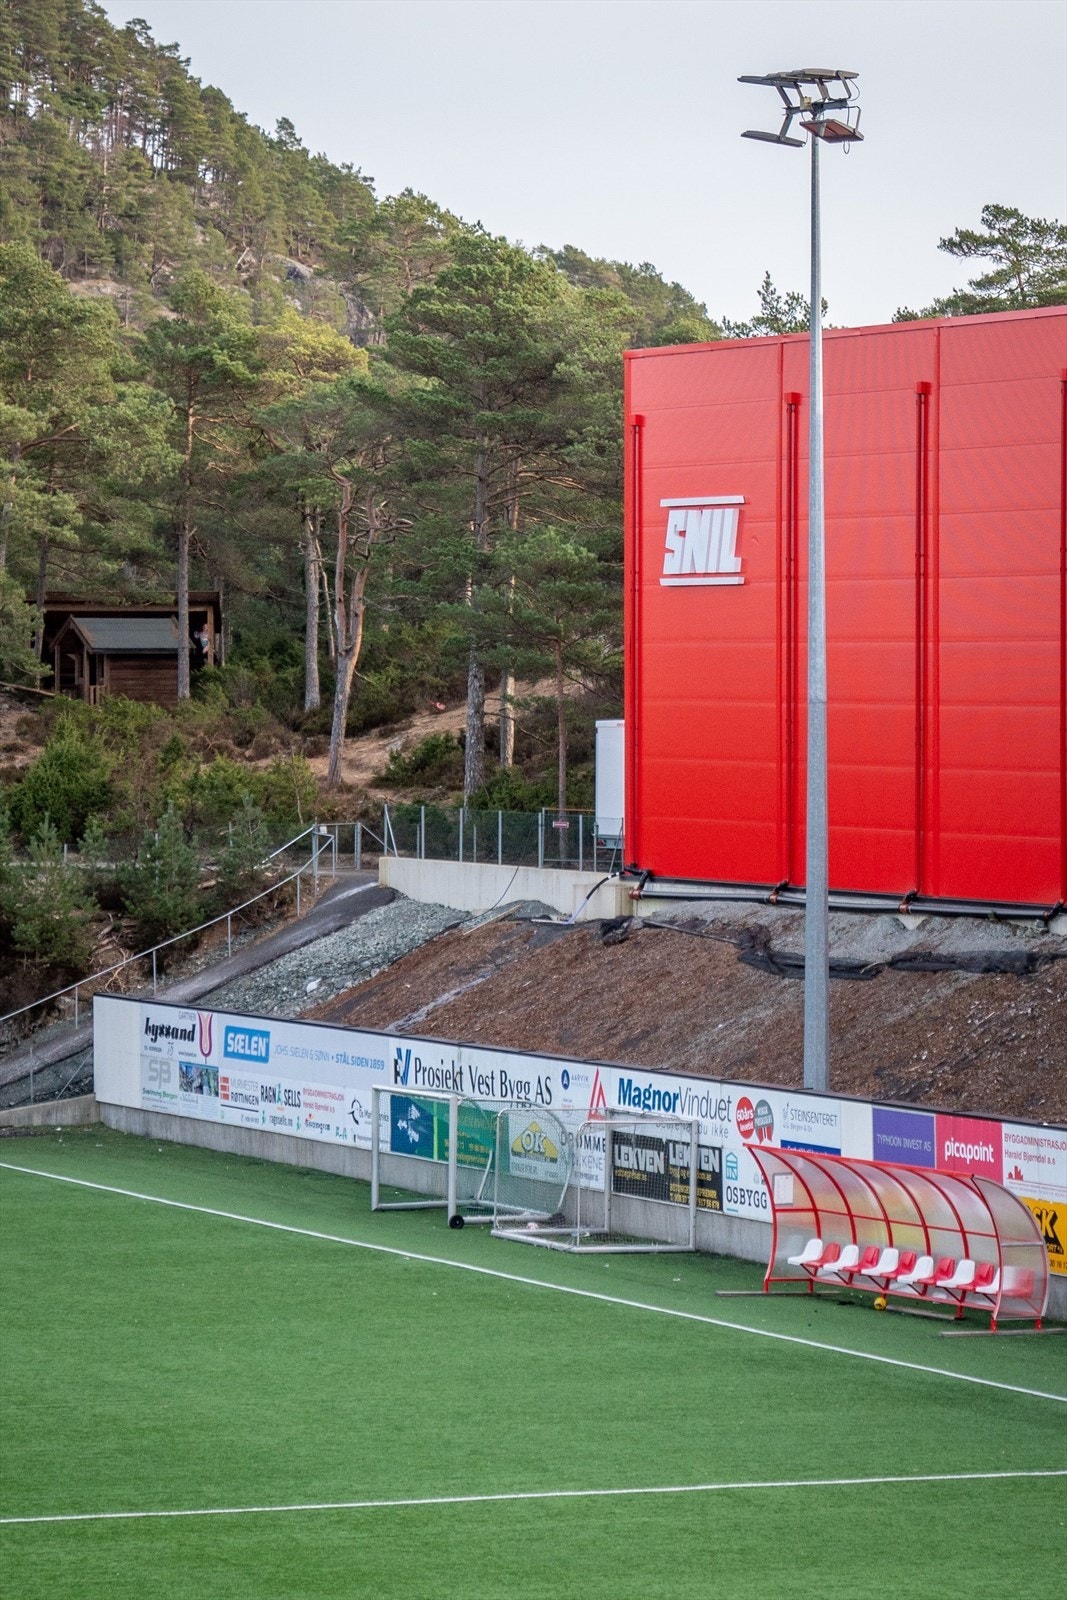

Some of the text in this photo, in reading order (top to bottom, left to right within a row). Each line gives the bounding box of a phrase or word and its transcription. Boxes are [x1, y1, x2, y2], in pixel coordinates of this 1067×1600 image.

[663, 508, 742, 575] SNIL
[227, 1032, 268, 1057] SÆLEN
[335, 1051, 350, 1066] STÅL
[351, 1055, 369, 1068] SIDEN
[369, 1059, 385, 1071] 1859
[469, 1065, 496, 1098] Vest
[500, 1069, 531, 1106] Bygg
[535, 1075, 553, 1106] AS
[790, 1108, 838, 1128] STEINSENTERET
[521, 1130, 547, 1154] OK
[711, 1122, 729, 1139] ikke
[876, 1133, 932, 1152] TYPHOON INVEST AS
[1004, 1133, 1067, 1151] BYGGADMINISTRASJO
[614, 1144, 665, 1174] LEKVEN
[669, 1142, 720, 1174] LEKEN
[944, 1136, 995, 1165] picapoint
[1004, 1148, 1023, 1160] Harald
[1023, 1151, 1047, 1164] Bjørndal
[726, 1185, 768, 1210] OSBYGG
